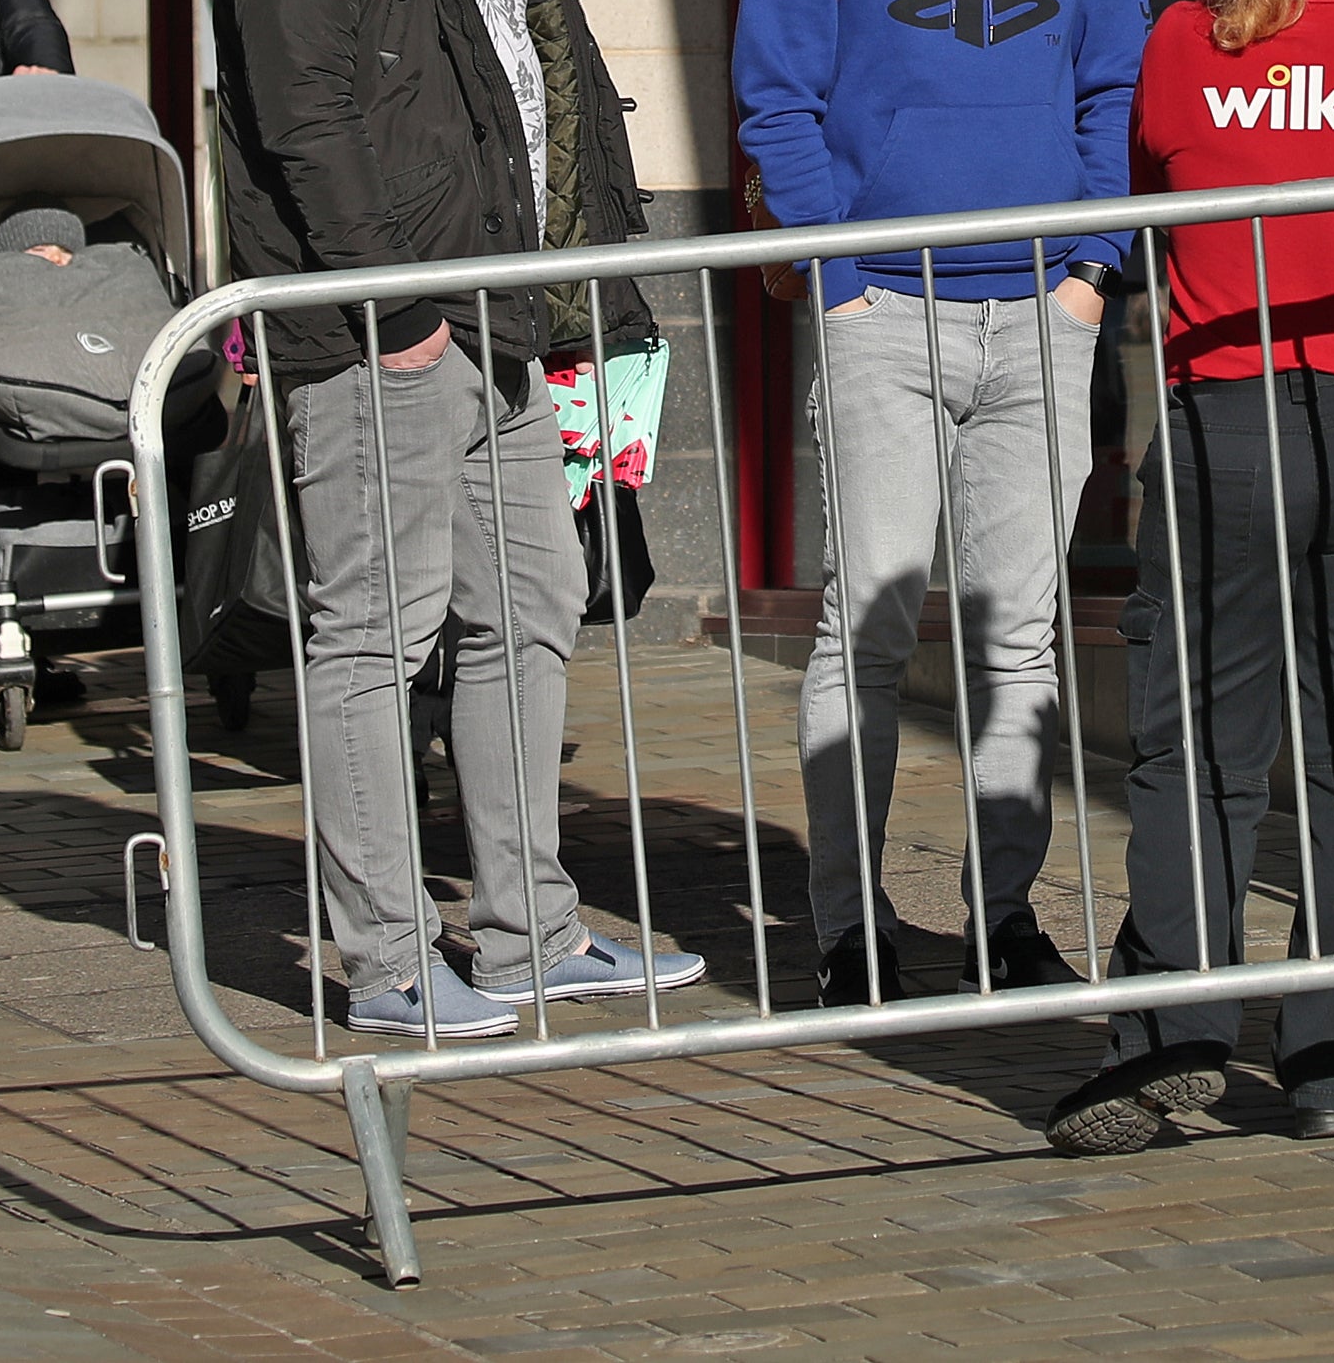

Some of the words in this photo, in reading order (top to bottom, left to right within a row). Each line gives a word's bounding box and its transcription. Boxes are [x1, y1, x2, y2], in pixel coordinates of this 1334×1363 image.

[1044, 34, 1061, 47] TM
[187, 503, 218, 527] SHOP
[218, 496, 237, 514] BA
